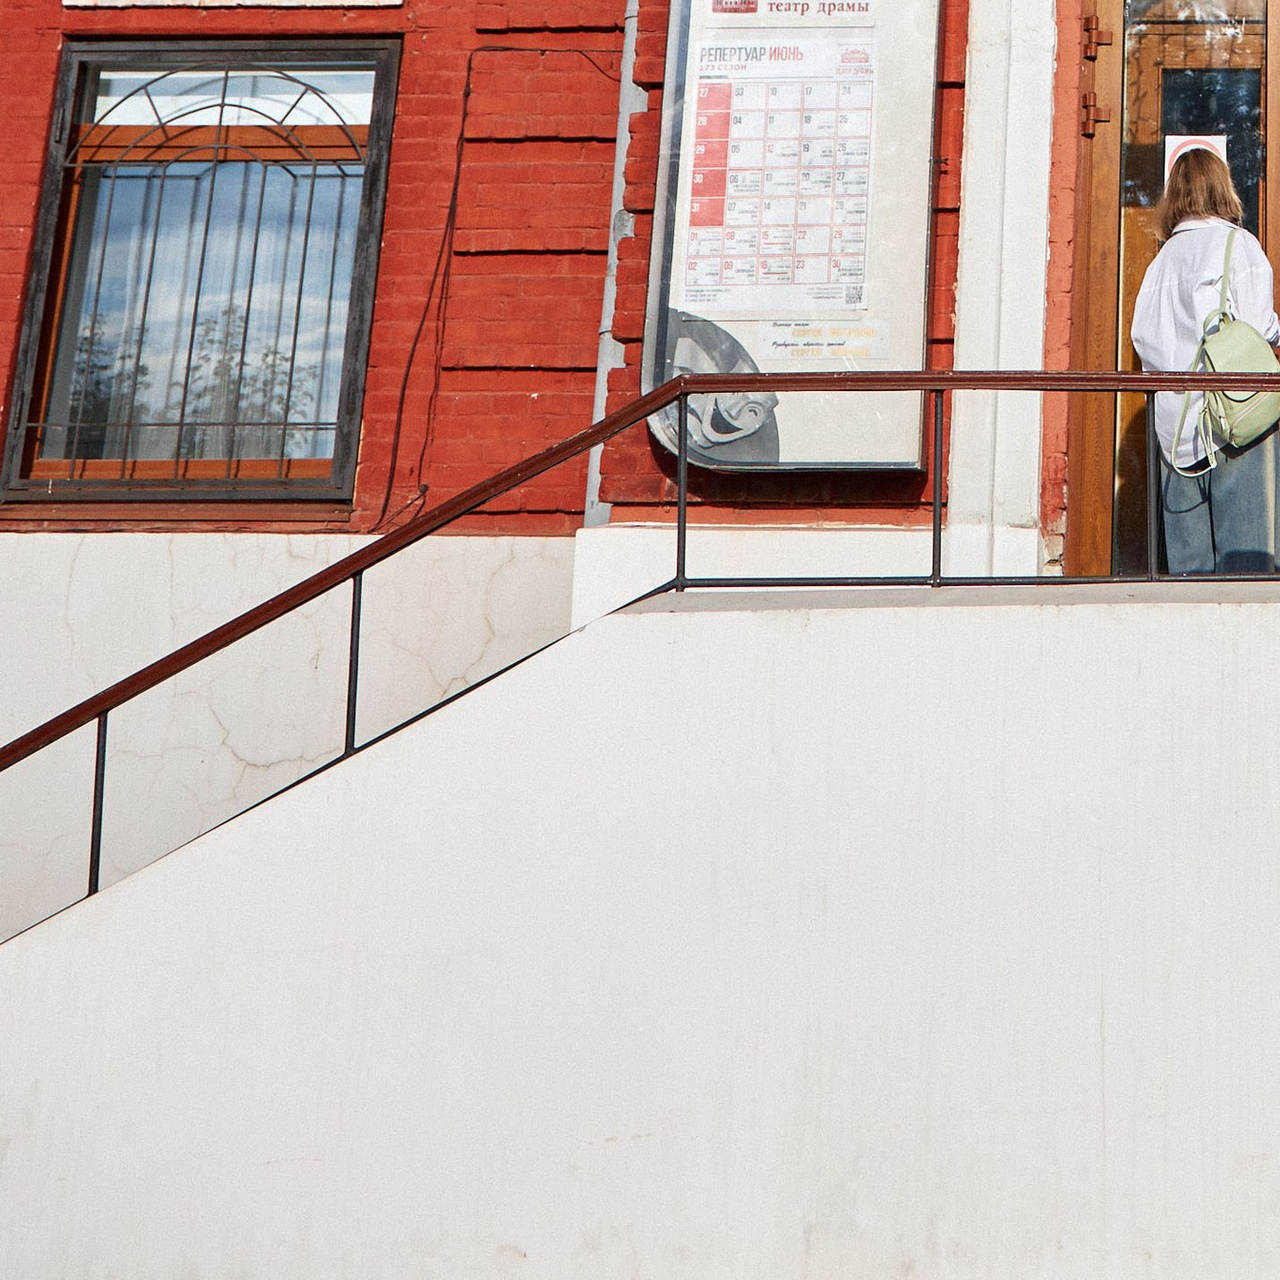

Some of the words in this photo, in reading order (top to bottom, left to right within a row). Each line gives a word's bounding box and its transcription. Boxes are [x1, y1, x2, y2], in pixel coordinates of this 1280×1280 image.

[768, 1, 810, 16] театр
[817, 1, 869, 16] драмы
[700, 47, 767, 62] РЕПЕРТУАР
[769, 46, 804, 61] ИЮНЬ
[805, 87, 813, 96] 17
[733, 116, 742, 125] 04
[695, 145, 705, 155] 29
[767, 144, 775, 153] 12
[802, 144, 810, 153] 19
[693, 174, 703, 183] 30
[836, 172, 845, 181] 27
[691, 203, 700, 212] 31
[762, 231, 769, 240] 15
[797, 230, 807, 239] 22
[833, 230, 843, 239] 29
[796, 260, 805, 269] 23
